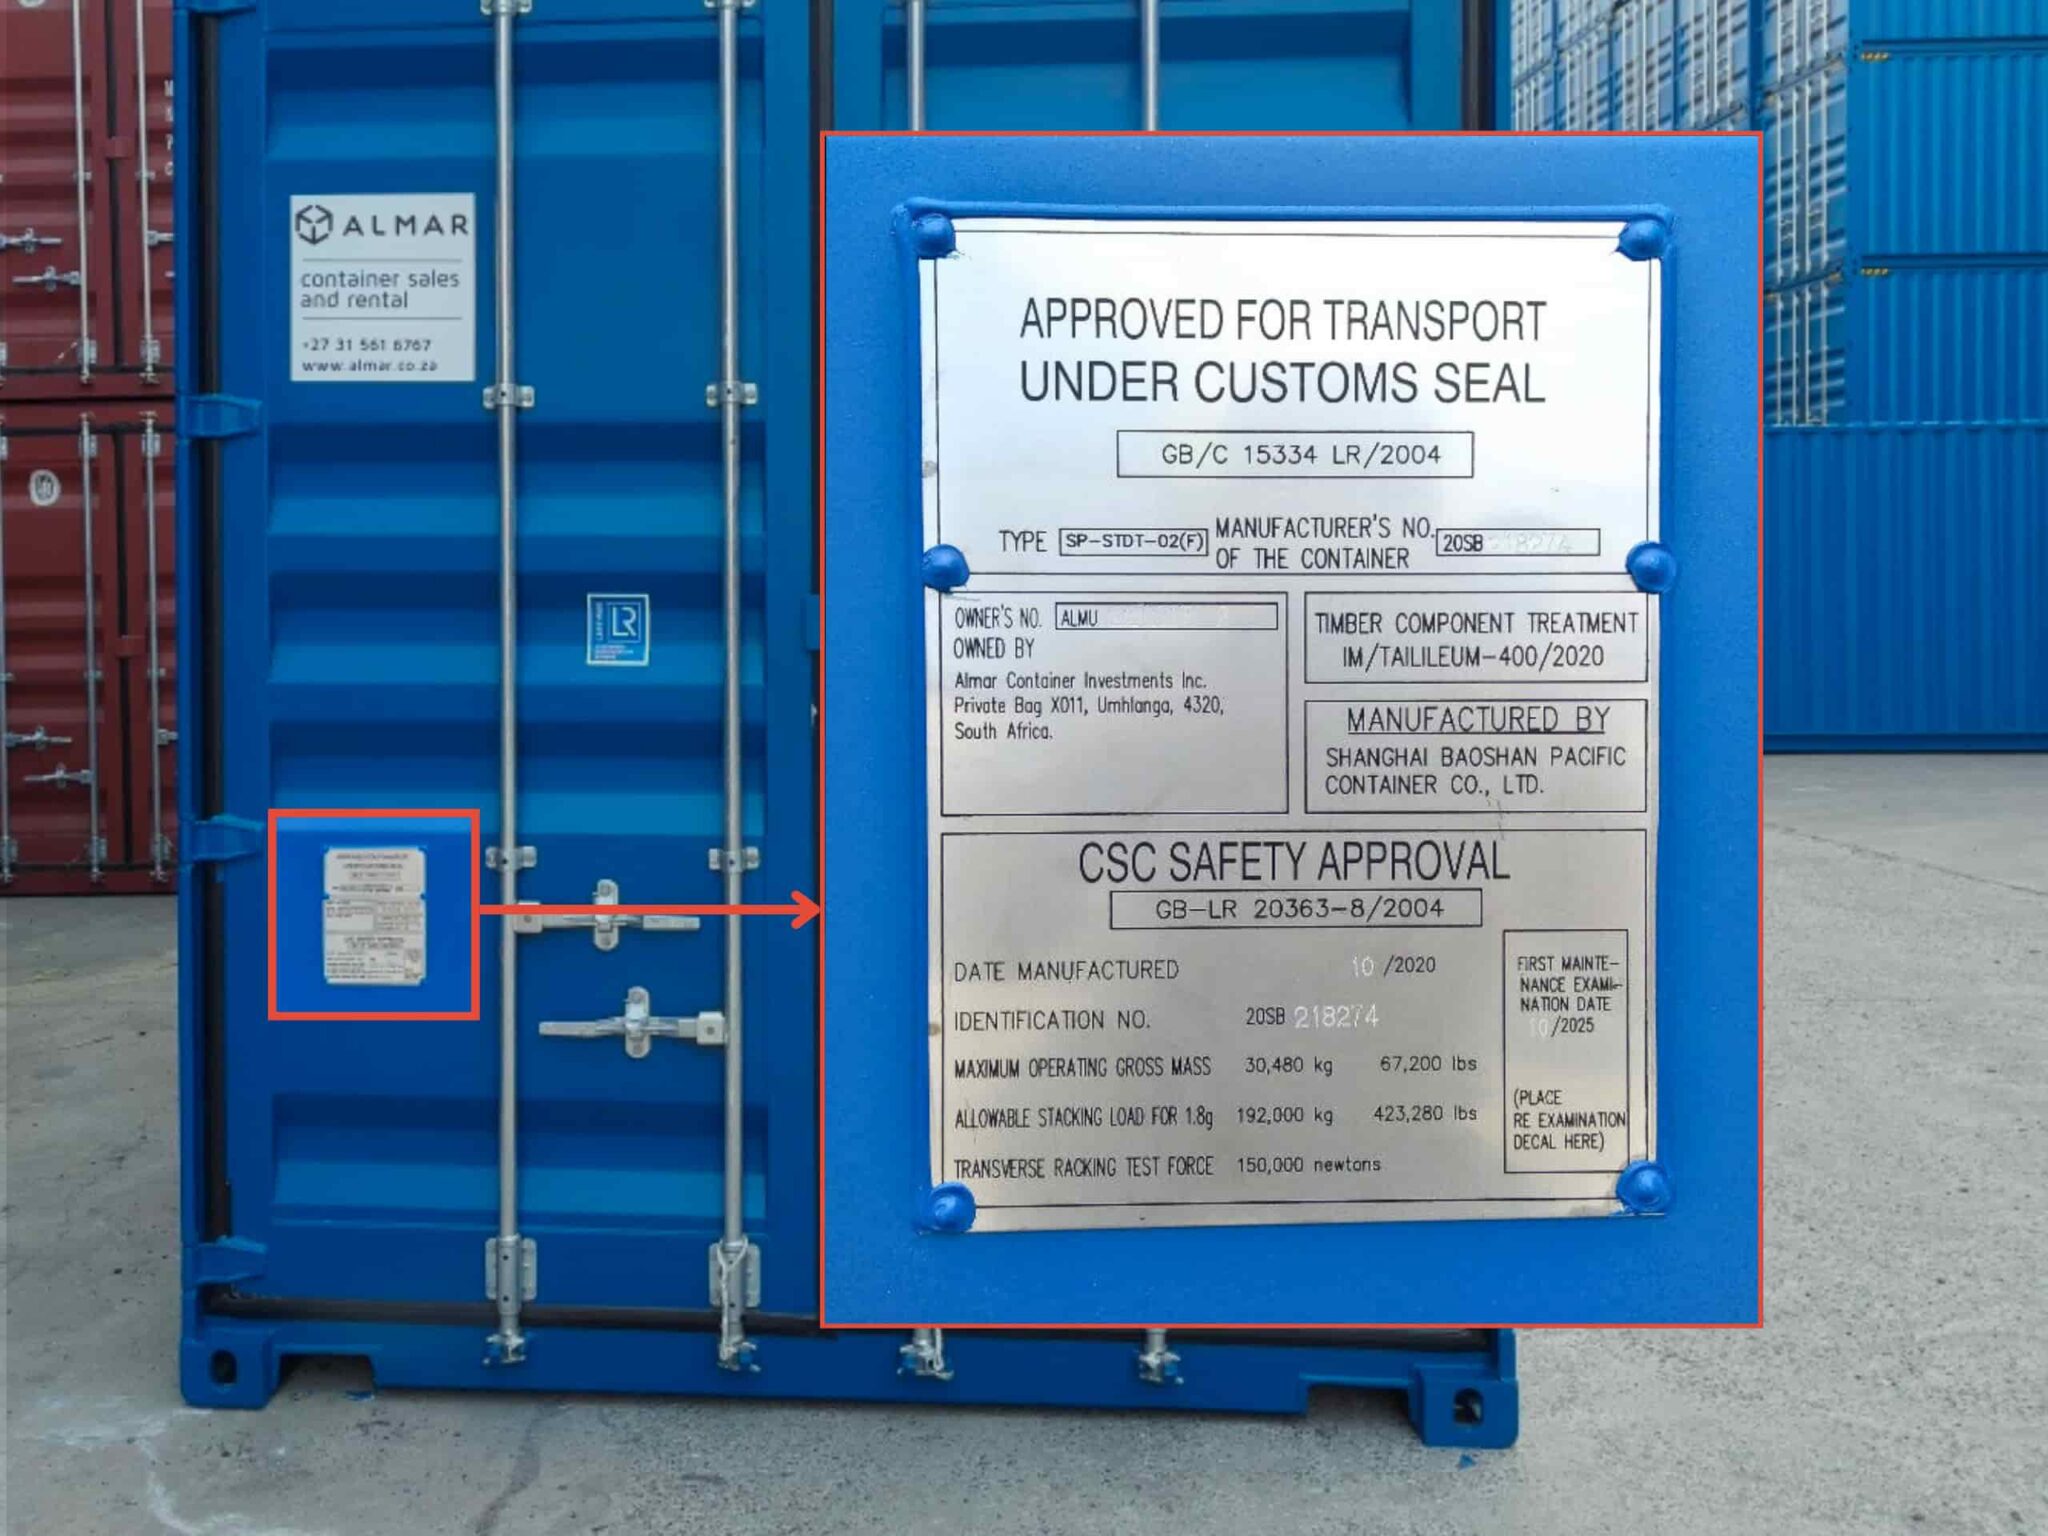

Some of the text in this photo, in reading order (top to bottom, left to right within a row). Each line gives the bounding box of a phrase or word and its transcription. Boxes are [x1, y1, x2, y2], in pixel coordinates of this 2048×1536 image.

[342, 213, 469, 237] ALMAR
[300, 268, 460, 289] container sales
[300, 290, 408, 309] and rental
[1019, 296, 1548, 342] APPROVED FOR TRANSPORT
[335, 337, 353, 352] 31
[1021, 360, 1546, 404] UNDER CUSTOMS SEAL
[1161, 441, 1441, 470] GB/C 15334 LR/2004
[1215, 516, 1435, 539] MANUFACTURER'S NO.
[998, 529, 1204, 553] TYPE SP-STDT-02(F)
[1443, 533, 1484, 553] 20SB
[1215, 546, 1410, 570] OF THE CONTAINER
[613, 607, 636, 636] LR
[954, 606, 1043, 630] OWNER'S NO.
[1060, 609, 1098, 628] ALMU
[1314, 611, 1640, 635] TIMBER COMPONENT TREATMENT
[953, 636, 1035, 660] OWNED BY
[1343, 641, 1604, 674] IM/TAILILEUM-400/2020
[954, 670, 1207, 690] Almar Container Investments Inc.
[954, 694, 1224, 719] Private Bag X011, Umhlanga, 4320,
[954, 721, 1053, 740] South Africa.
[1348, 708, 1610, 732] MANUFACTURED BY
[1326, 745, 1626, 768] SHANGHAI BAOSHAN PACIFIC
[1325, 773, 1545, 798] CONTAINER CO., LTD.
[1079, 839, 1511, 884] CSC SAFETY APPROVAL
[1155, 895, 1445, 923] GB-LR 20363-8/2004
[954, 960, 1006, 983] DATE
[1016, 960, 1180, 981] MANUFACTURED
[1517, 954, 1620, 972] FIRST MAINTE-
[1519, 975, 1566, 993] NANCE
[1520, 995, 1612, 1013] NATION DATE
[954, 1005, 1381, 1032] IDENTIFICATION NO. 20SB 218274
[954, 1054, 1478, 1079] MAXIMUM OPERATING GROSS MASS 30,480 kg 67,200 lbs
[1513, 1087, 1563, 1110] (PLACE
[954, 1104, 1477, 1132] ALLOWABLE STACKING LOAD FOR 1.8g 192,000 kg 423,280 lbs
[1513, 1111, 1626, 1129] RE EXAMINATION
[1513, 1130, 1605, 1153] DECAL HERE)
[953, 1155, 1382, 1180] TRANSVERSE RACKING TEST FORCE 150,000 newtons
